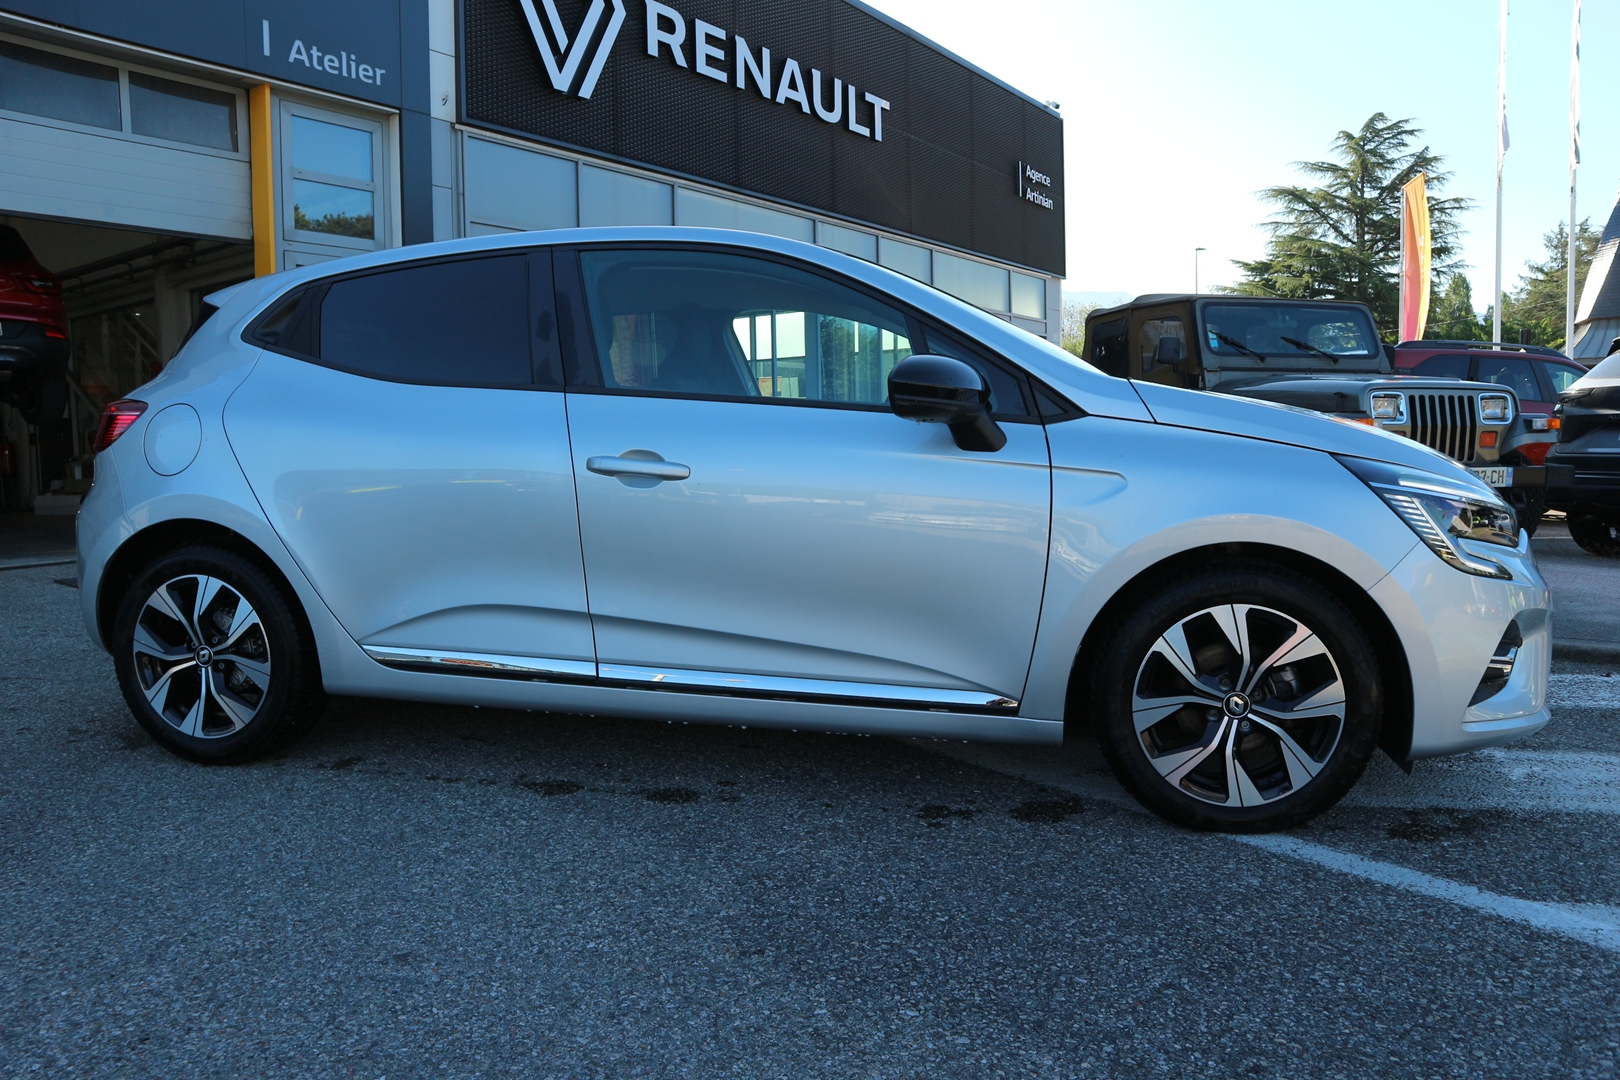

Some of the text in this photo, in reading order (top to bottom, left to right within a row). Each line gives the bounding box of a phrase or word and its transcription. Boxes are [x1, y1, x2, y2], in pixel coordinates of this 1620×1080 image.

[288, 39, 386, 86] Atelier
[645, 0, 890, 142] RENAULT
[1026, 164, 1051, 187] Agence
[1026, 187, 1054, 210] Artinian
